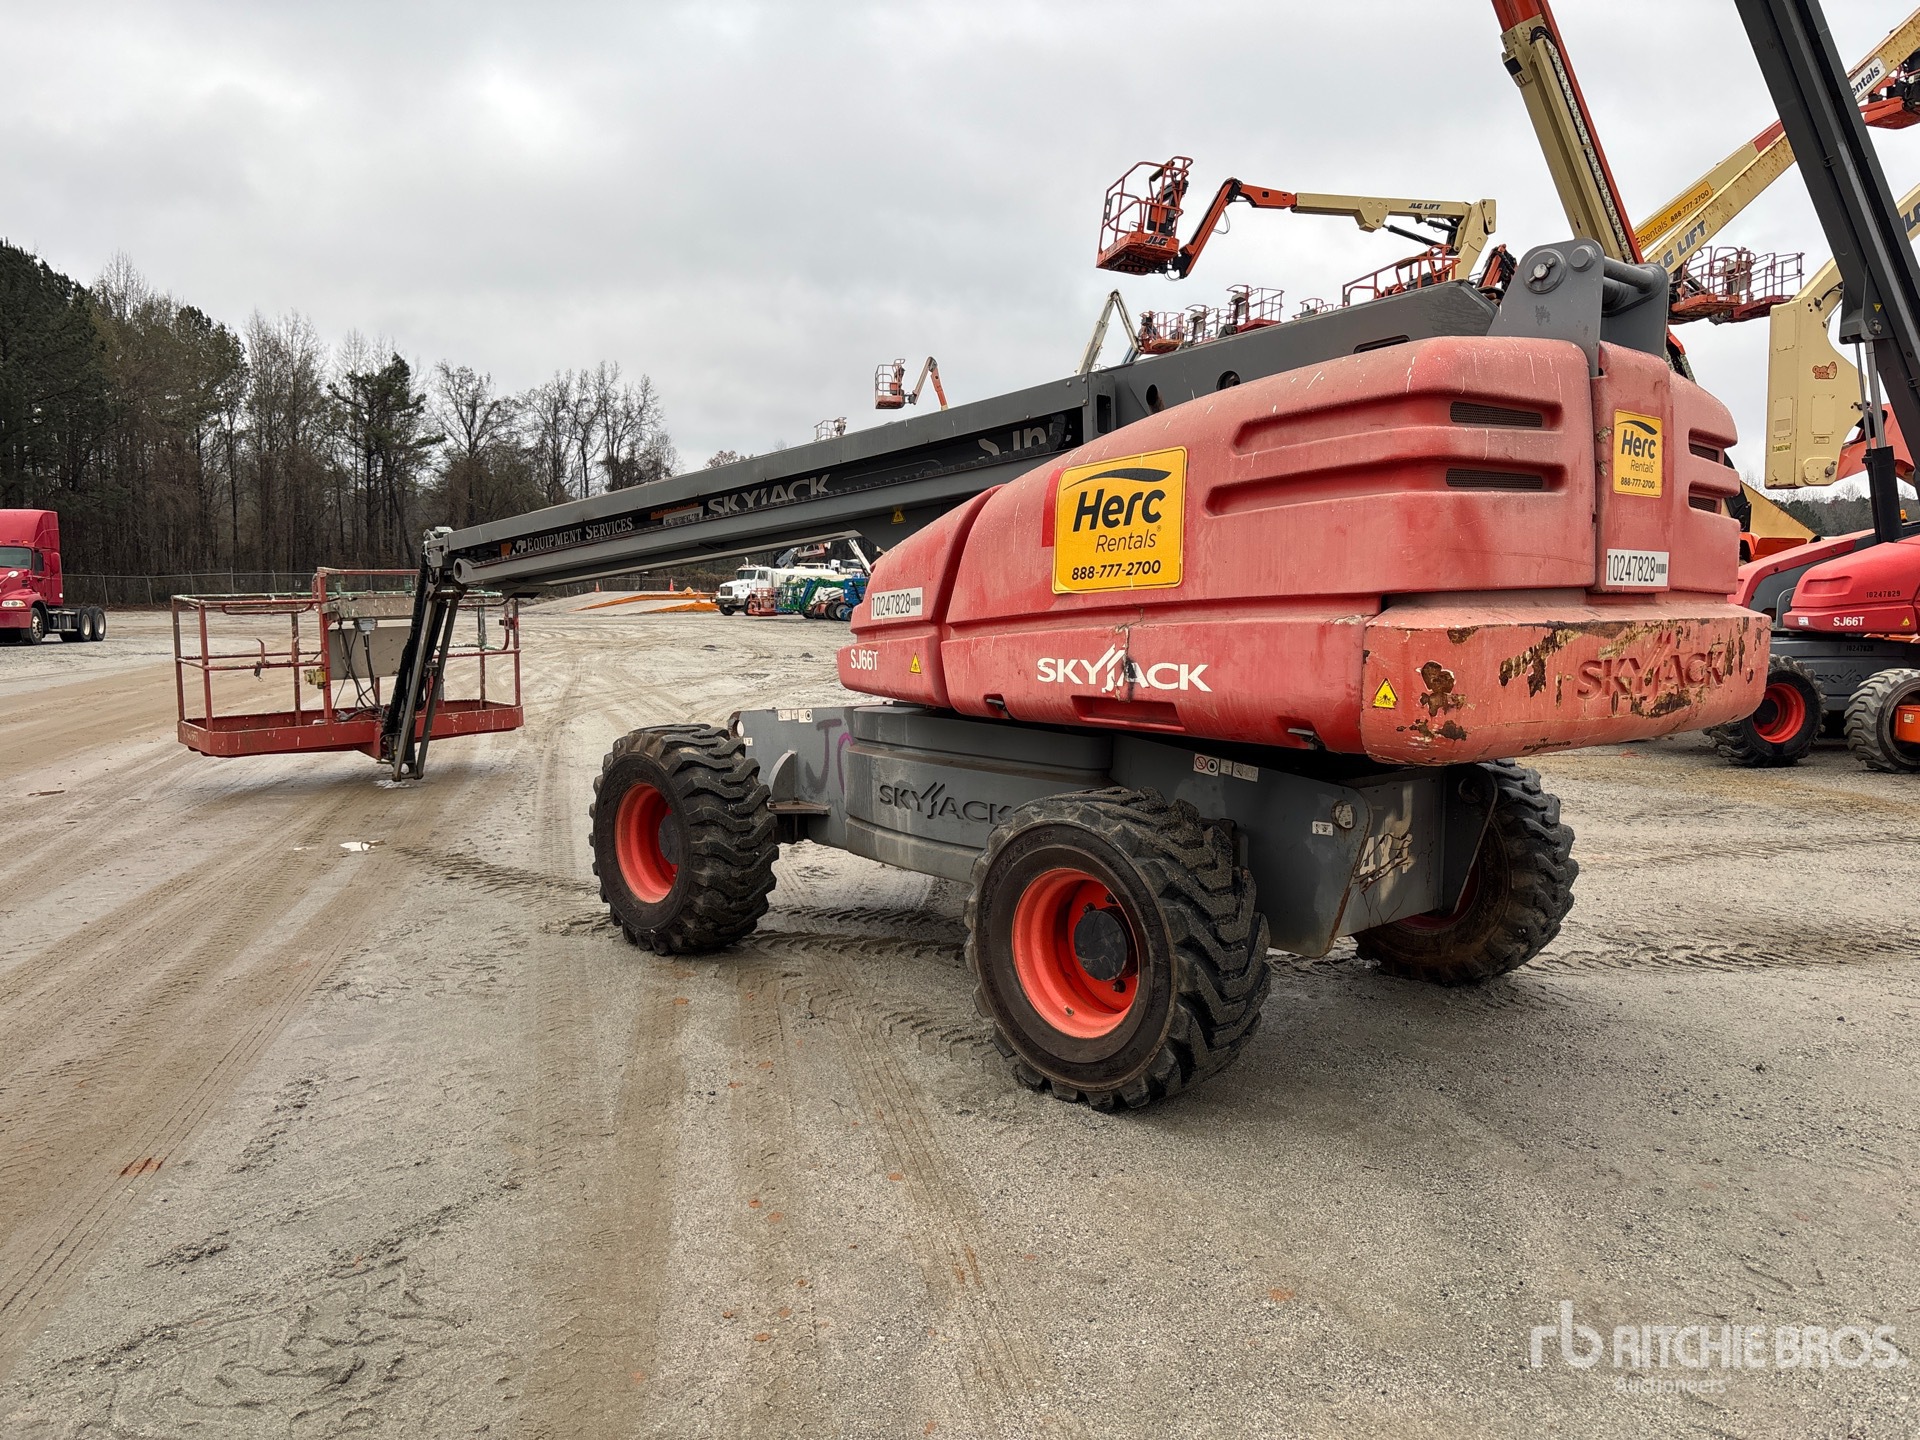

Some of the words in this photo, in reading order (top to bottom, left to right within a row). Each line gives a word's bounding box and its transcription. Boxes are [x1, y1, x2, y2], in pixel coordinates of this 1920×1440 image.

[1851, 66, 1880, 96] entals
[1640, 220, 1668, 245] Rentals
[1676, 219, 1706, 257] LIFT
[1621, 429, 1656, 459] Herc
[1630, 459, 1654, 474] Rentals
[1620, 476, 1656, 489] 888-777-2700
[1072, 488, 1167, 532] Herc
[527, 528, 581, 552] EQUIPMENT
[585, 517, 633, 540] SERVICES
[1095, 528, 1158, 554] Rentals
[1071, 559, 1161, 581] 888-777-2700
[1607, 554, 1656, 582] 10247828
[872, 592, 911, 617] 10247828
[1833, 616, 1865, 627] SJ66T
[850, 648, 879, 671] SJ66T
[1037, 643, 1213, 692] SKYJACK
[1577, 630, 1724, 704] SKYJACK
[879, 782, 1013, 825] SKYJACK
